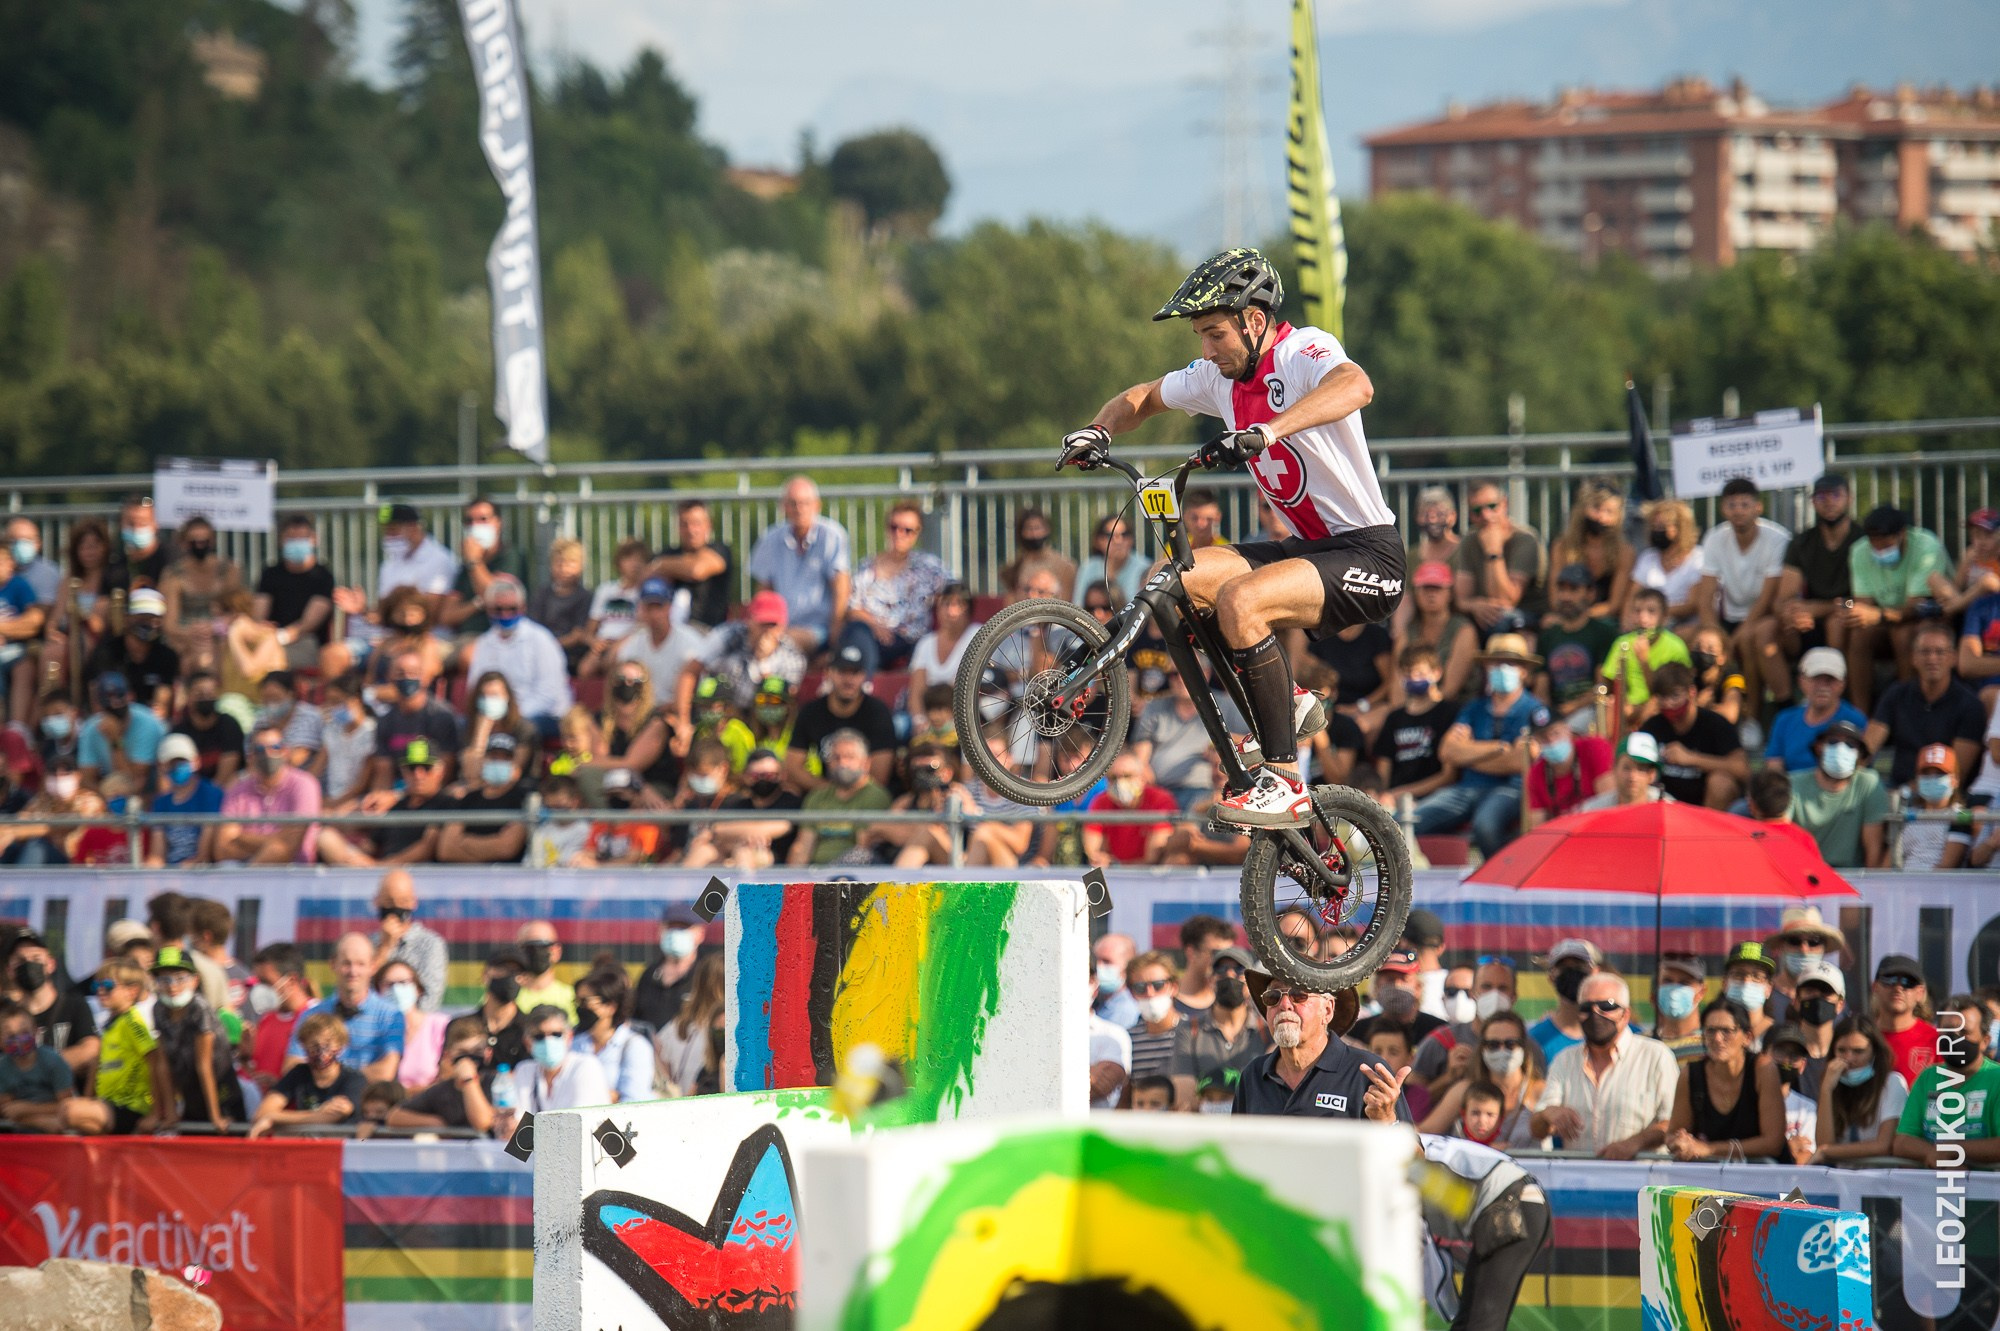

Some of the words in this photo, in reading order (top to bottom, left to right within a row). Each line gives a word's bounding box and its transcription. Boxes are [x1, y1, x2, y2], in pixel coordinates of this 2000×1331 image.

[1147, 493, 1166, 512] 117
[1342, 569, 1403, 592] CLEAN
[1342, 582, 1379, 596] hebo
[1321, 1095, 1345, 1109] UCI
